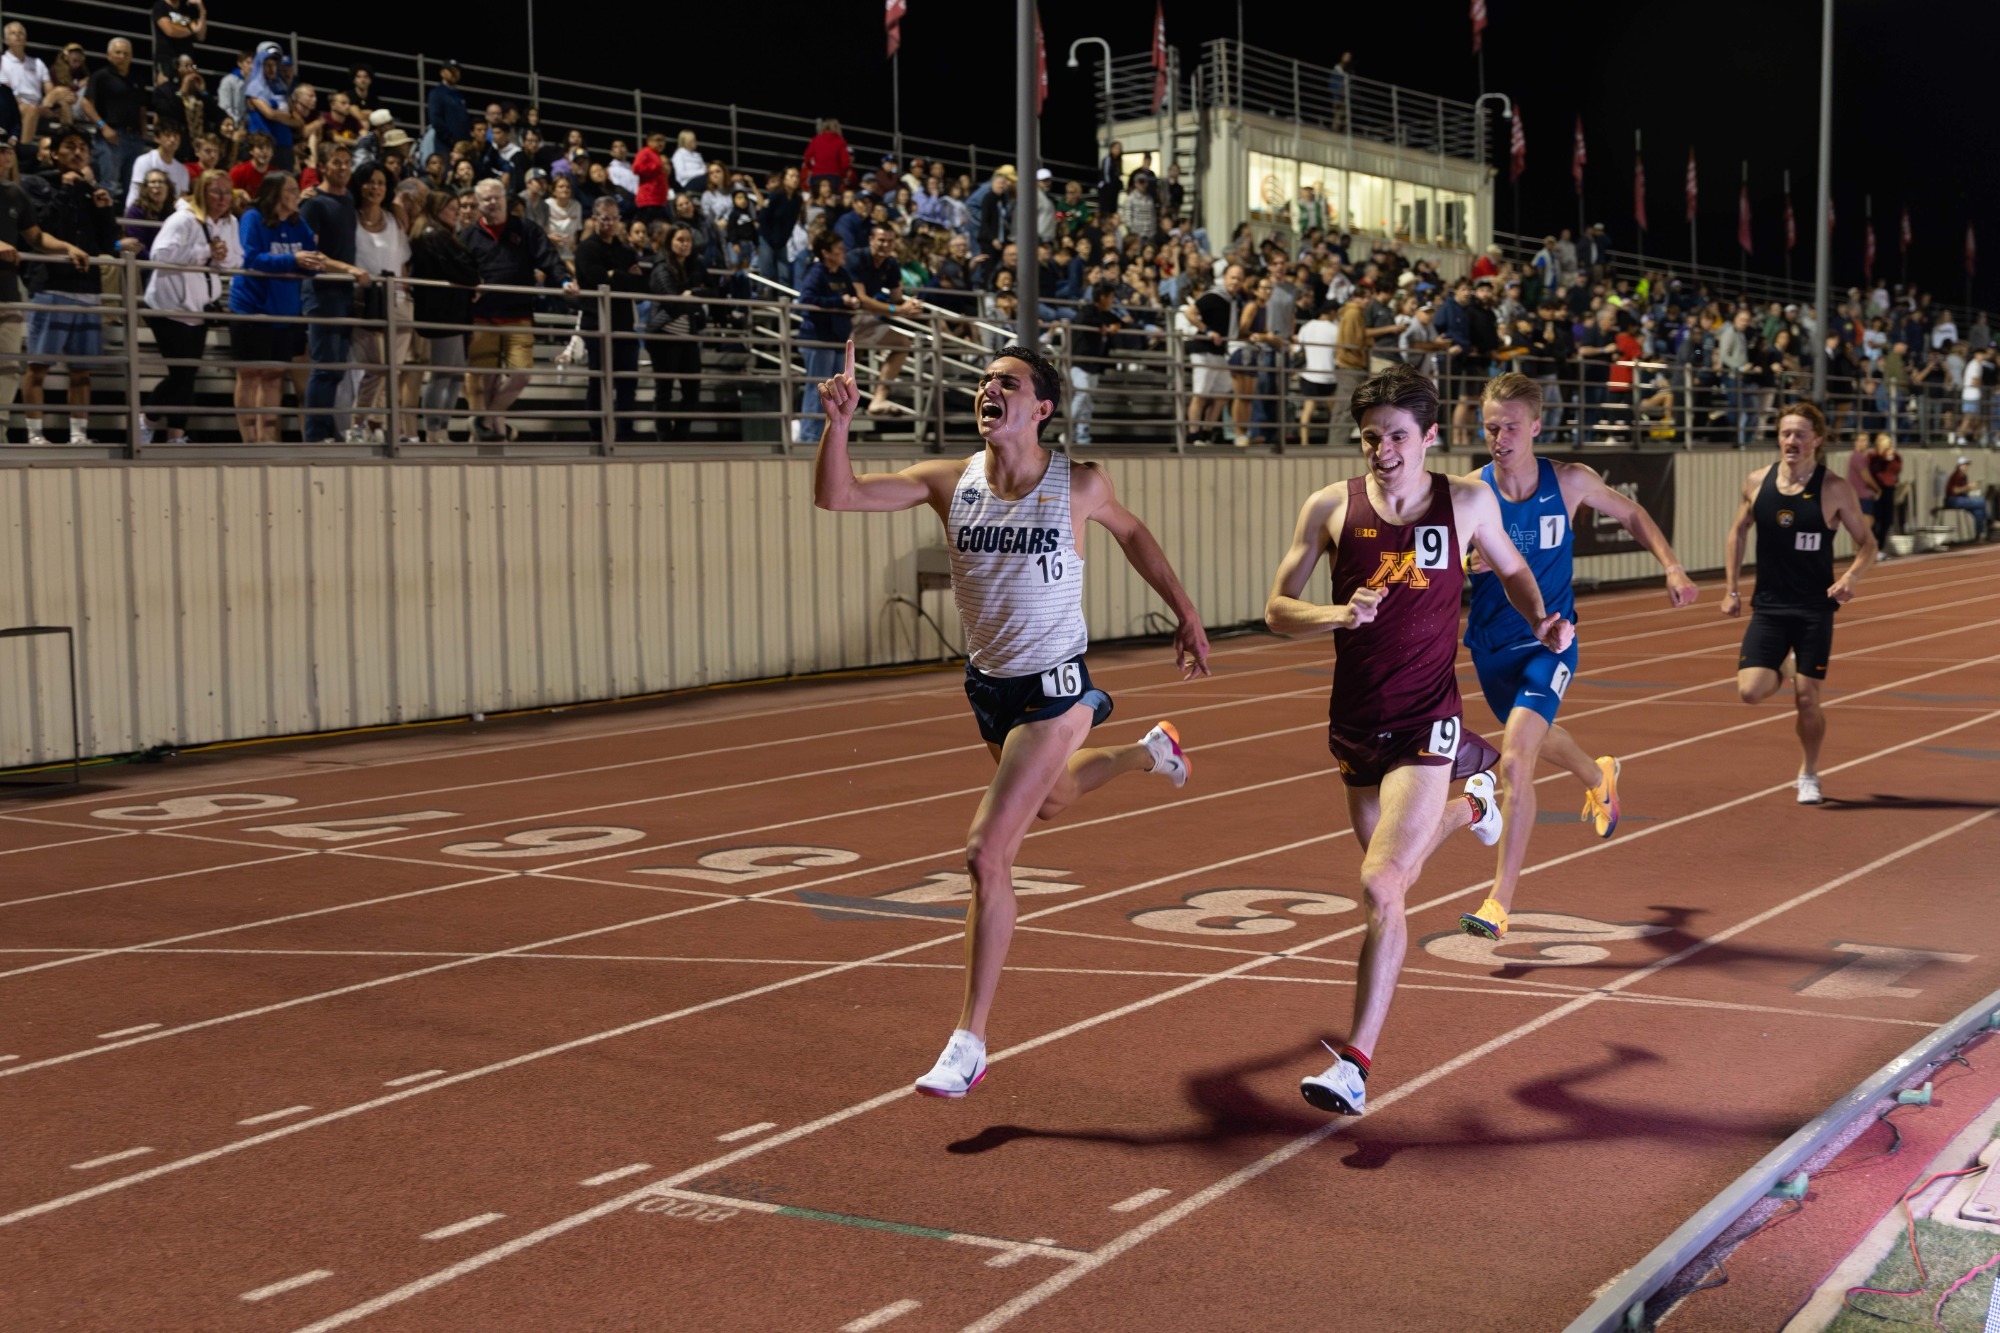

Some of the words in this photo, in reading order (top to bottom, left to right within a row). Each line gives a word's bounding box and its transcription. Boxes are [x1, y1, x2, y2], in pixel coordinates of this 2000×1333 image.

[957, 525, 1060, 554] COUGARS
[1422, 528, 1442, 567] 9
[1546, 517, 1557, 546] 1
[1800, 534, 1816, 549] 11
[1036, 551, 1063, 584] 16
[1366, 550, 1430, 589] M
[1048, 664, 1077, 696] 16
[1558, 670, 1569, 695] 1
[1437, 717, 1456, 754] 9
[89, 792, 299, 821] 8
[240, 809, 465, 842] 7
[439, 825, 647, 858] 6
[627, 845, 860, 884] 5
[872, 865, 1086, 904] 4
[1128, 887, 1358, 935] 3
[1420, 910, 1674, 967] 2
[1796, 940, 1979, 998] 1
[636, 1197, 741, 1222] 800
